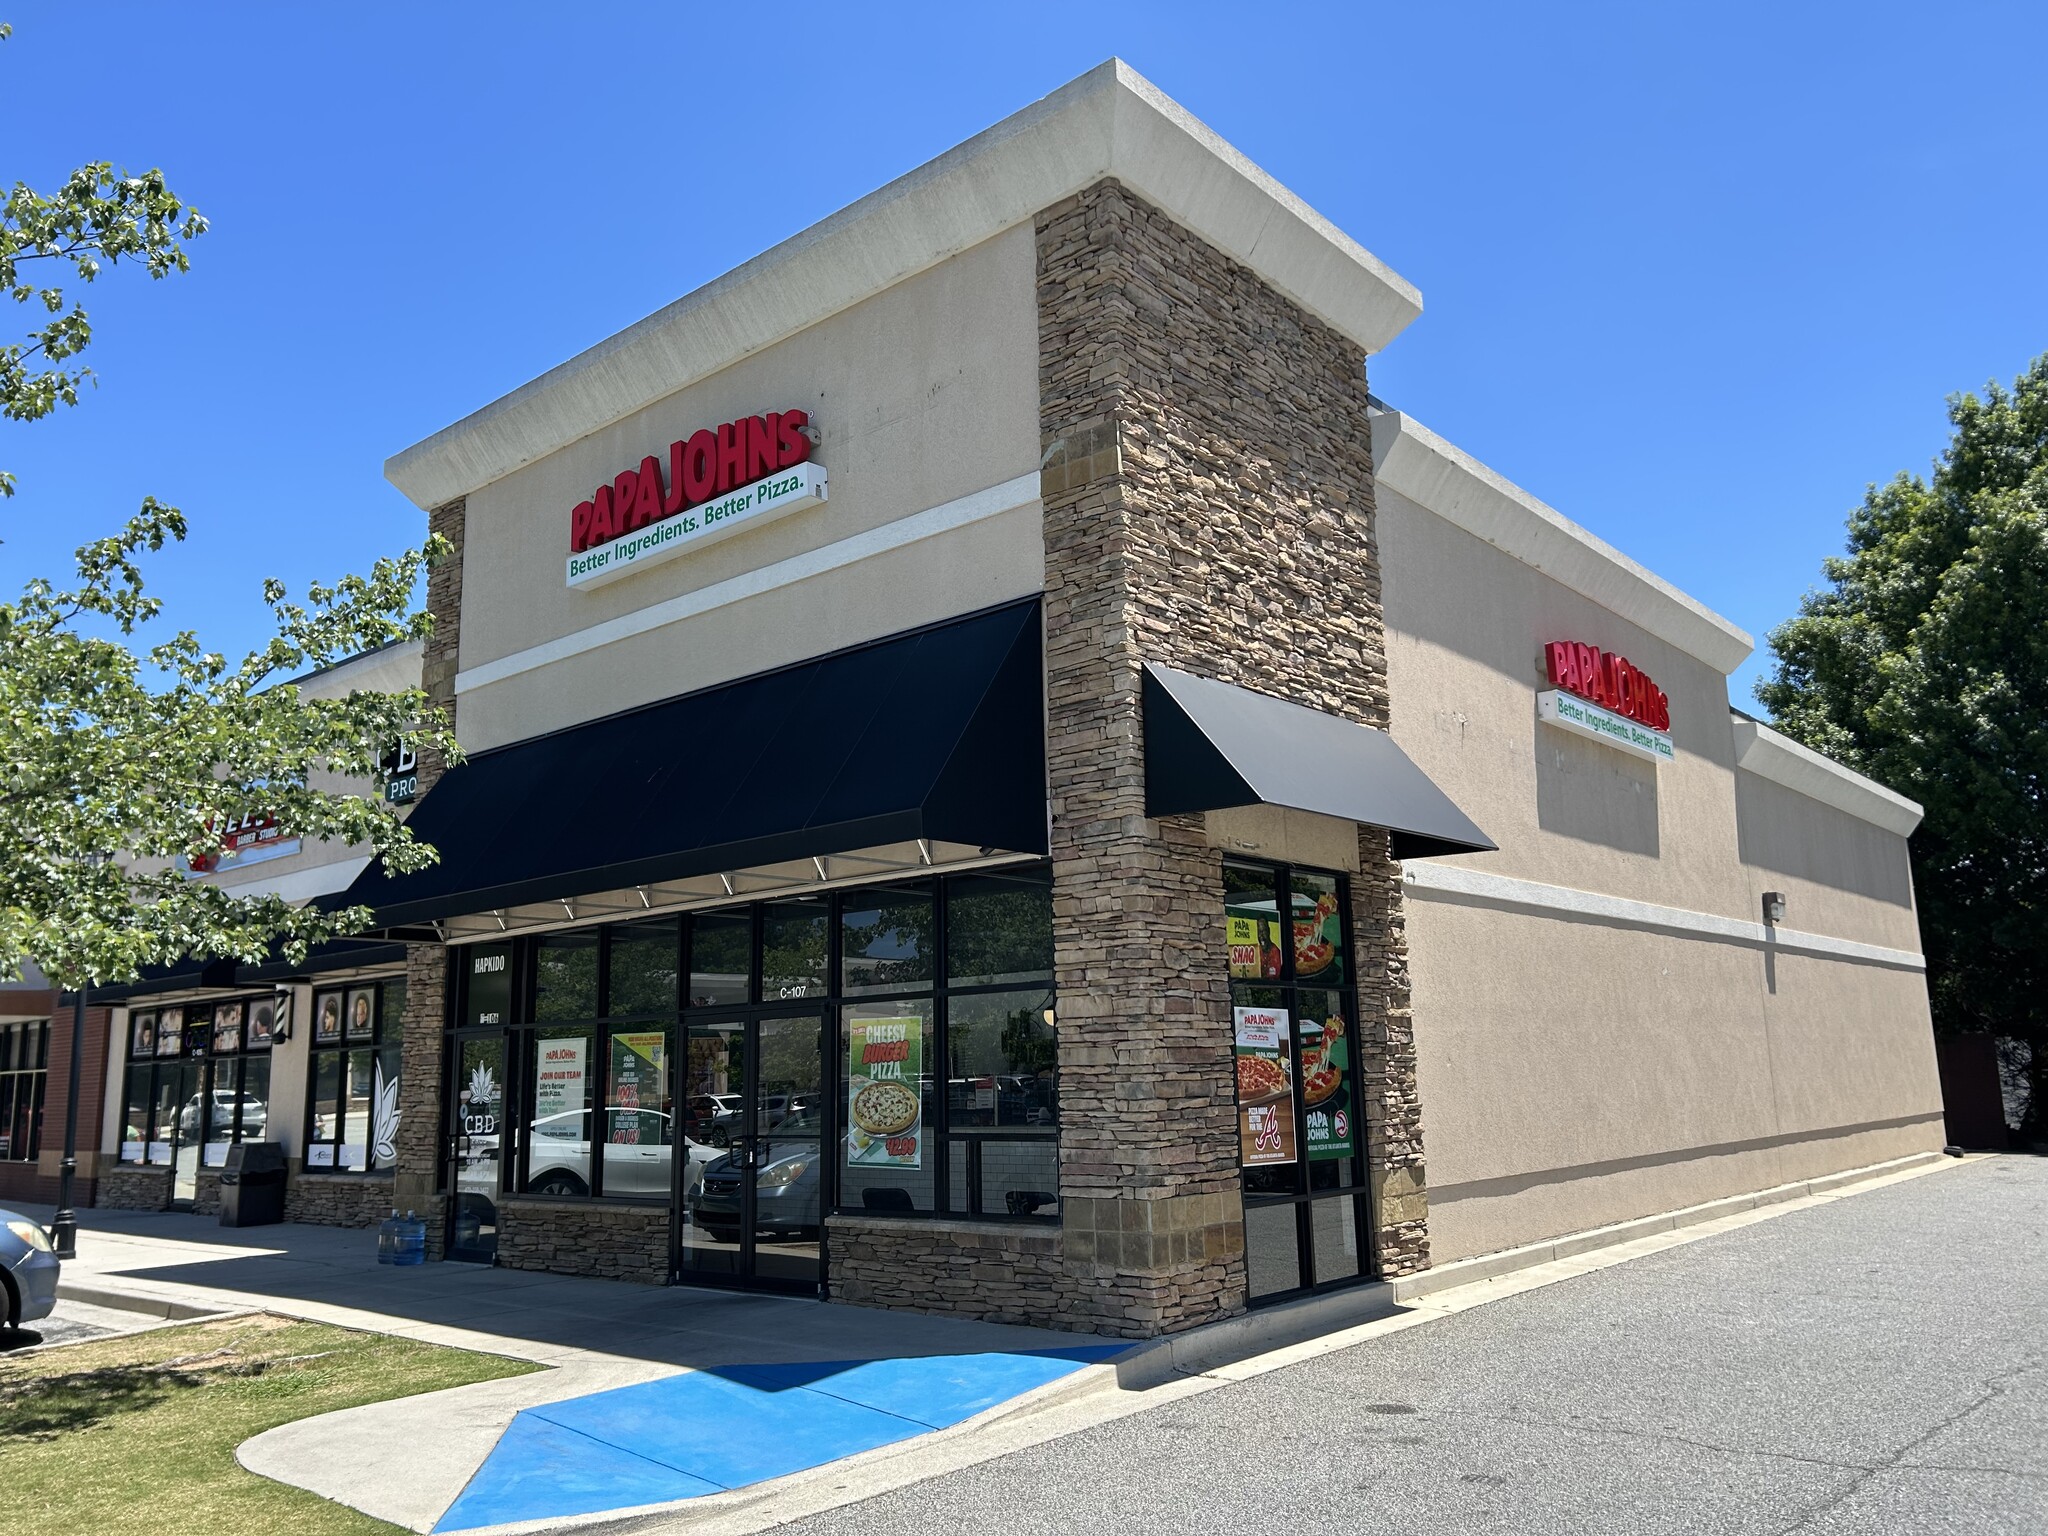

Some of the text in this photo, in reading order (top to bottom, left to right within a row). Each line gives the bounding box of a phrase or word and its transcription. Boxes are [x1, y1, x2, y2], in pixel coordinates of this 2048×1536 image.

[571, 409, 812, 553] PAPA JOHNS
[570, 474, 804, 578] Better Ingredients. Better Pizza.
[1545, 640, 1670, 732] PAPA JOHNS
[1557, 696, 1673, 757] Better Ingredients. Better Pizza.
[390, 776, 417, 799] PRO
[1234, 919, 1250, 931] PAPA
[1234, 930, 1251, 939] JOHNS
[475, 955, 505, 974] HAPKIDO
[1231, 945, 1256, 966] SHAQ
[780, 986, 807, 999] C-107
[1244, 1014, 1275, 1026] PAPA JOHNS
[866, 1024, 907, 1044] CHEESY
[546, 1049, 577, 1061] PAPA JOHNS
[623, 1054, 635, 1062] PAPA
[862, 1040, 910, 1065] BURGER
[540, 1070, 582, 1080] JOIN OUR TEAM
[871, 1061, 902, 1079] PIZZA
[552, 1082, 566, 1090] Better
[616, 1083, 638, 1103] 100%
[464, 1115, 495, 1134] CBD
[1306, 1111, 1328, 1128] PAPA
[612, 1128, 641, 1145] ON US!
[1307, 1128, 1330, 1141] JOHNS
[885, 1136, 917, 1156] $12.99
